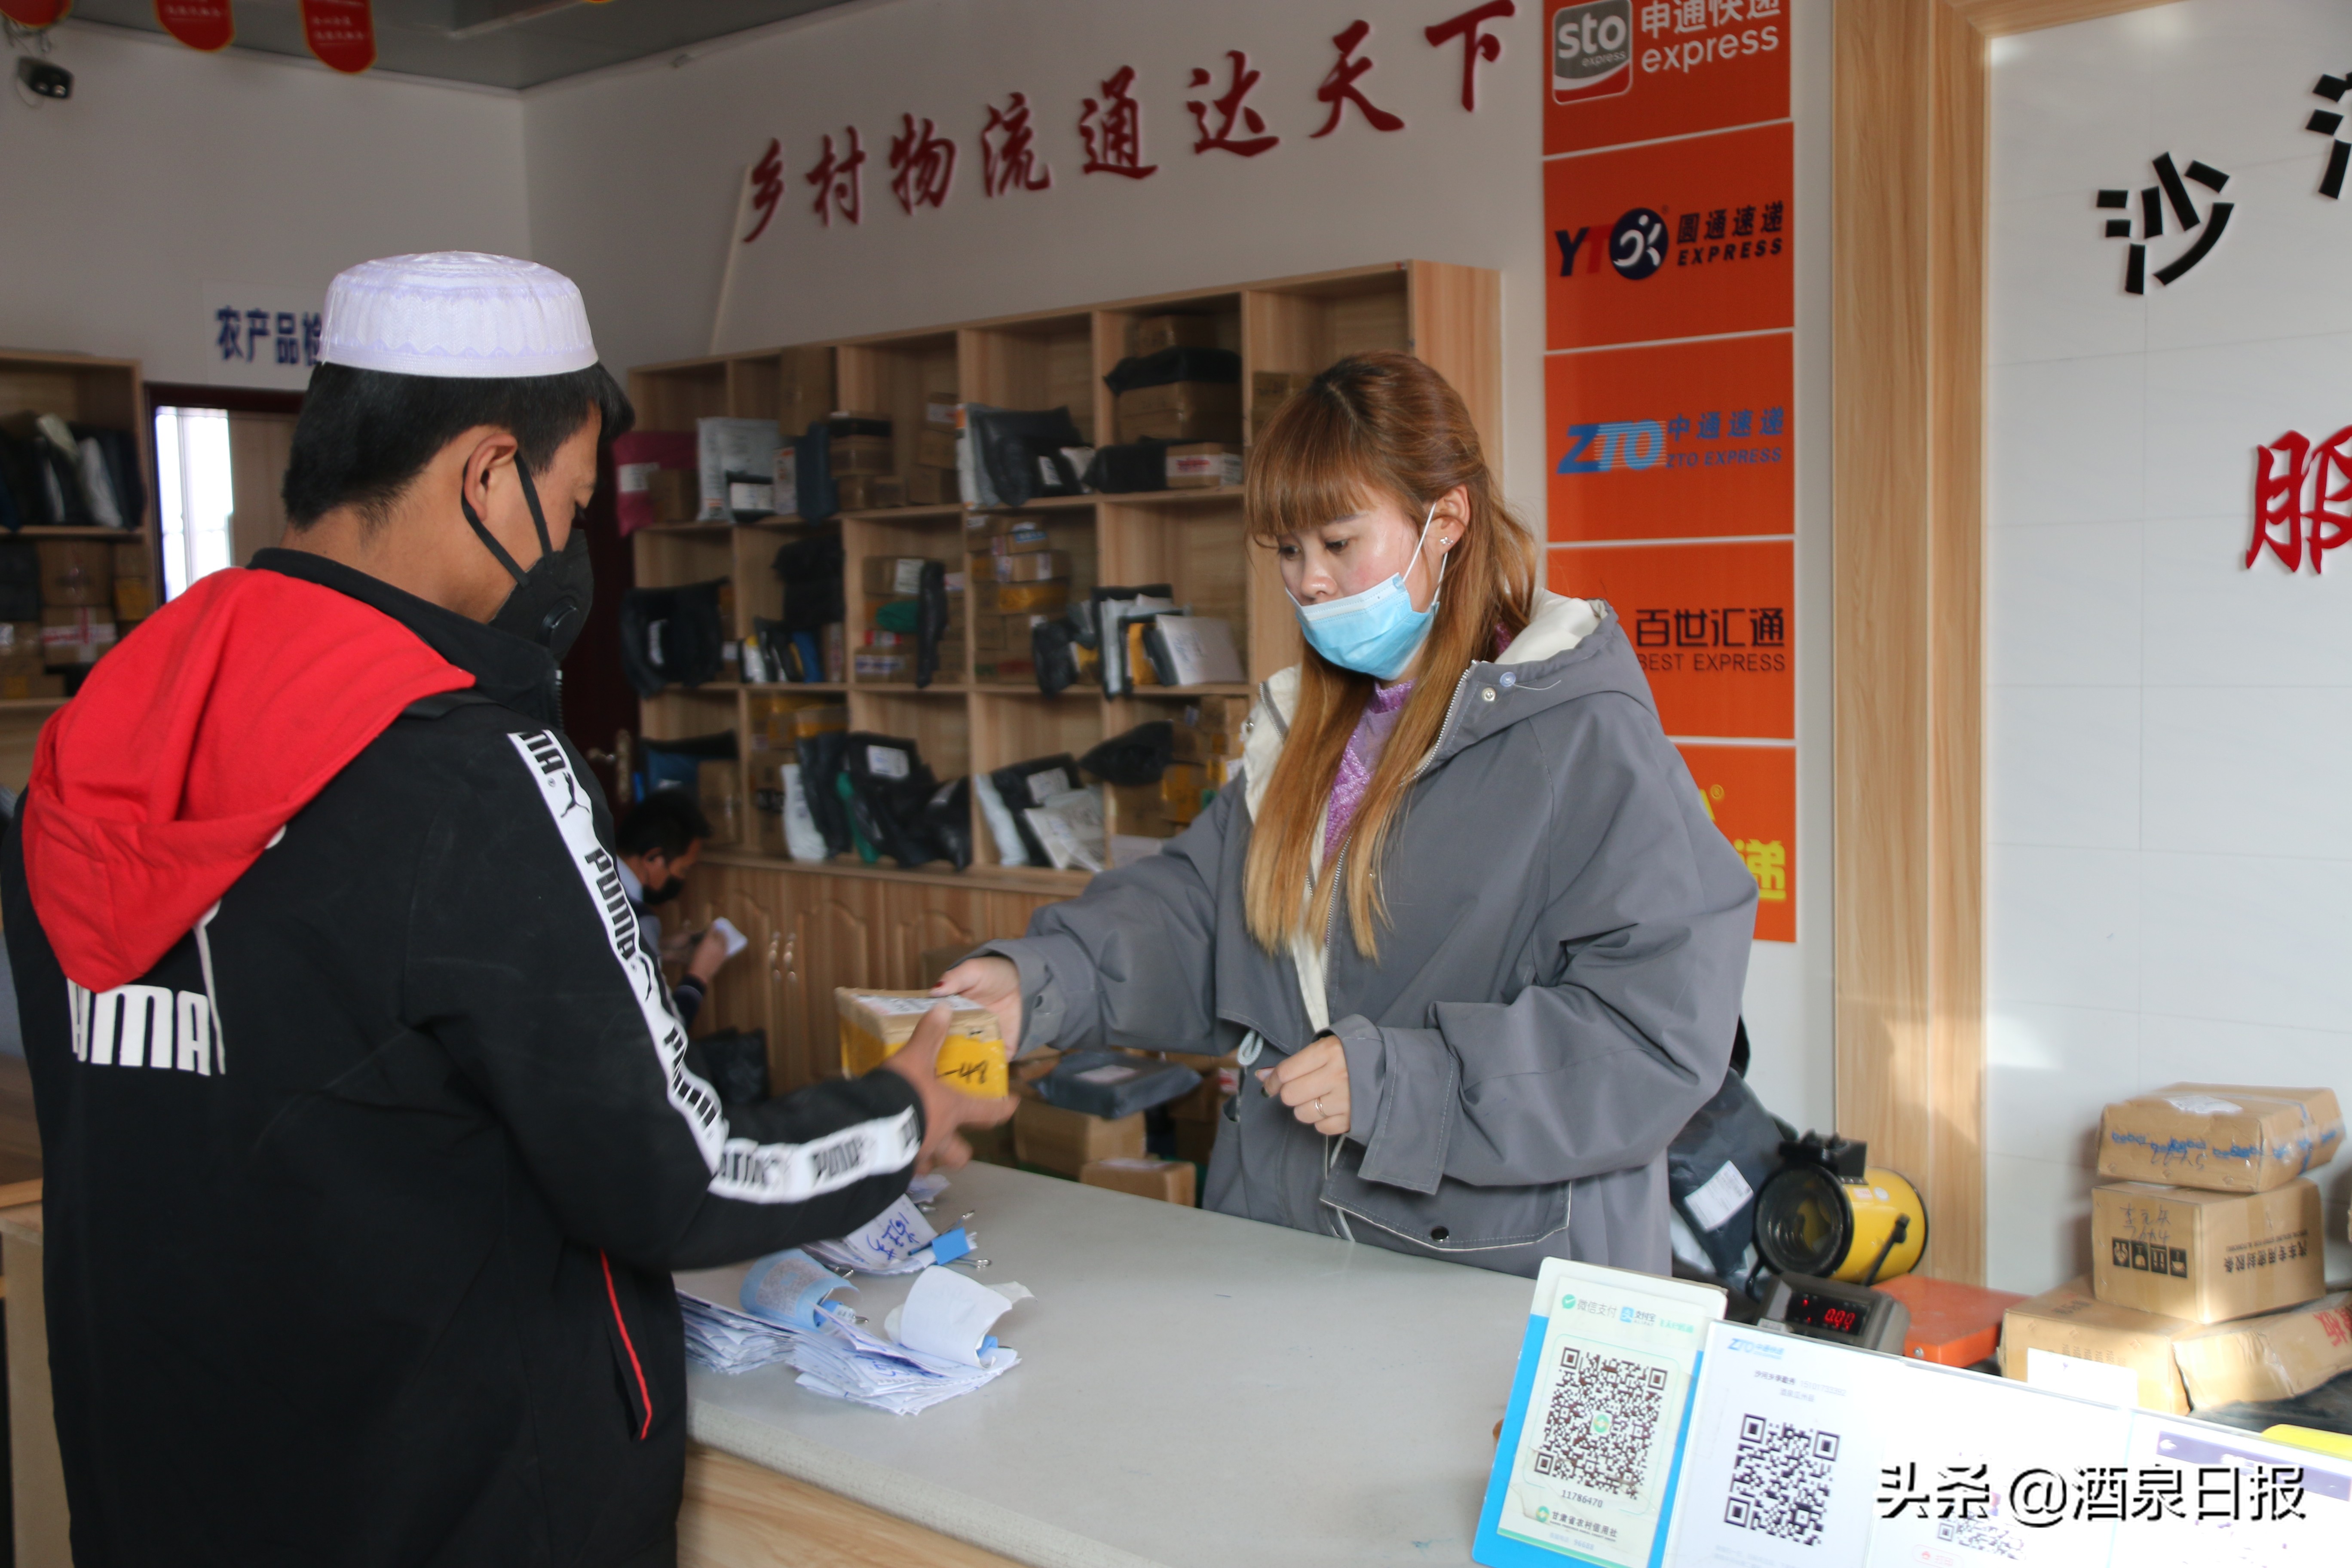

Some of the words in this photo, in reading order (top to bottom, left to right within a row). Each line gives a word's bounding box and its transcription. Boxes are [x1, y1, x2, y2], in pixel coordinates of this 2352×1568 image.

[1558, 12, 1626, 58] sto
[1582, 50, 1626, 67] express
[1642, 26, 1779, 74] express
[743, 0, 1516, 242] 乡村物流通达天下
[1678, 237, 1782, 266] EXPRESS
[1667, 405, 1784, 441] 中通速递
[1556, 419, 1666, 474] ZTO
[1665, 453, 1698, 469] ZTO
[1704, 447, 1782, 466] EXPRESS
[1636, 608, 1785, 647] 百世汇通
[1638, 653, 1684, 672] BEST
[1694, 653, 1785, 672] EXPRESS
[1577, 1298, 1617, 1318] 微信支付
[1635, 1311, 1656, 1323] 支付宝
[1562, 1489, 1603, 1508] 11786470
[1552, 1510, 1618, 1538] 甘肃省农村信用社
